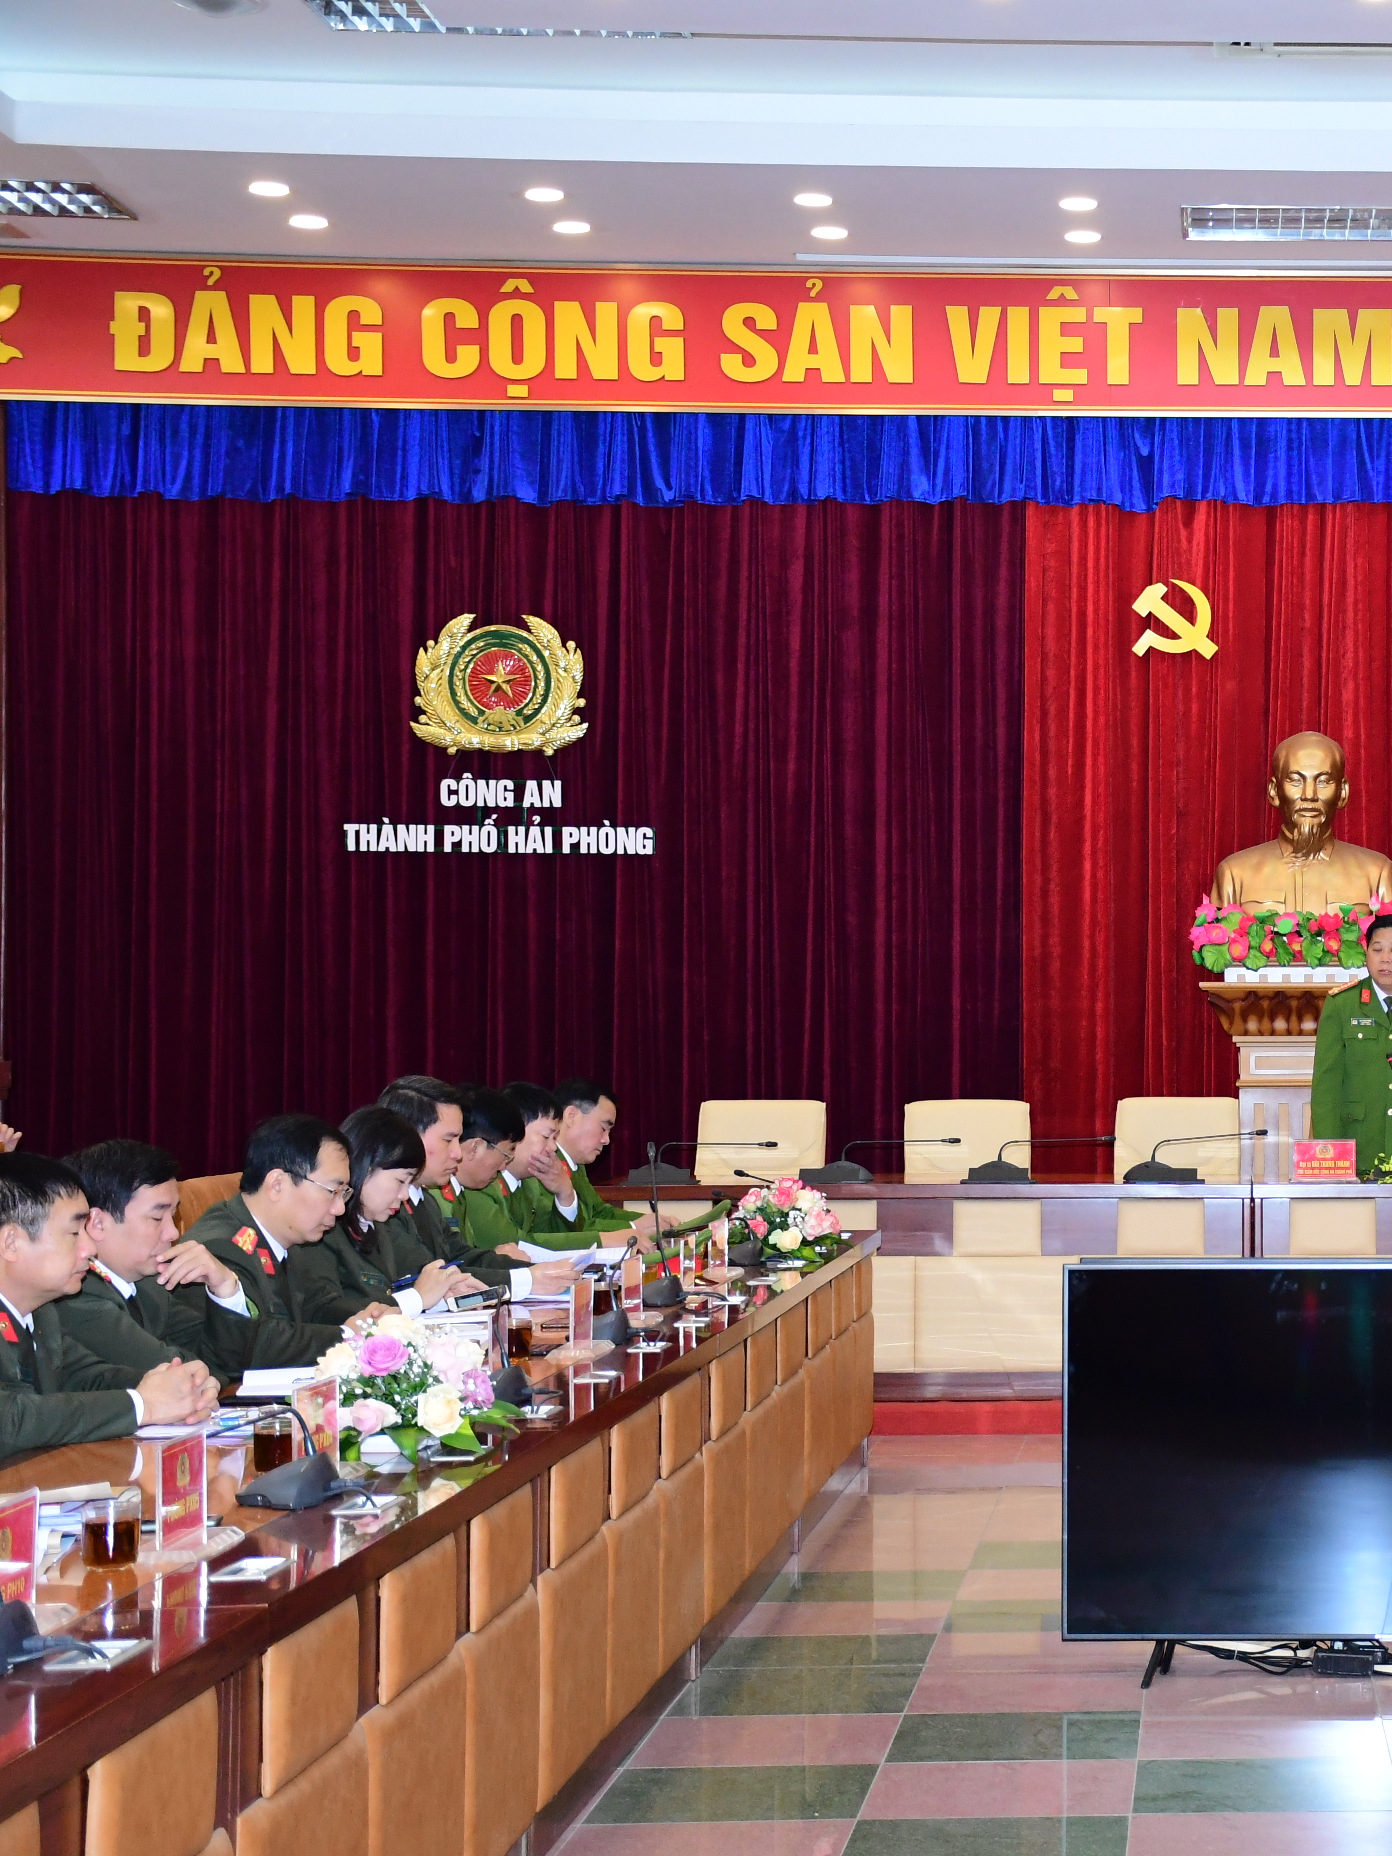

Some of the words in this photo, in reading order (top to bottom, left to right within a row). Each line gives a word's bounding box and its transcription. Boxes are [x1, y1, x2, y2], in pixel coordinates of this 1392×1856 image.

[109, 267, 384, 377] ĐẢNG
[421, 278, 686, 398] CỘNG
[719, 278, 915, 384] SẢN
[946, 286, 1143, 402] VIỆT
[1177, 306, 1392, 386] NAM
[440, 773, 515, 808] CÔNG
[522, 780, 562, 808] AN
[343, 817, 435, 853] THÀNH
[443, 813, 499, 854] PHỐ
[507, 815, 554, 854] HẢI
[562, 819, 654, 855] PHÒNG
